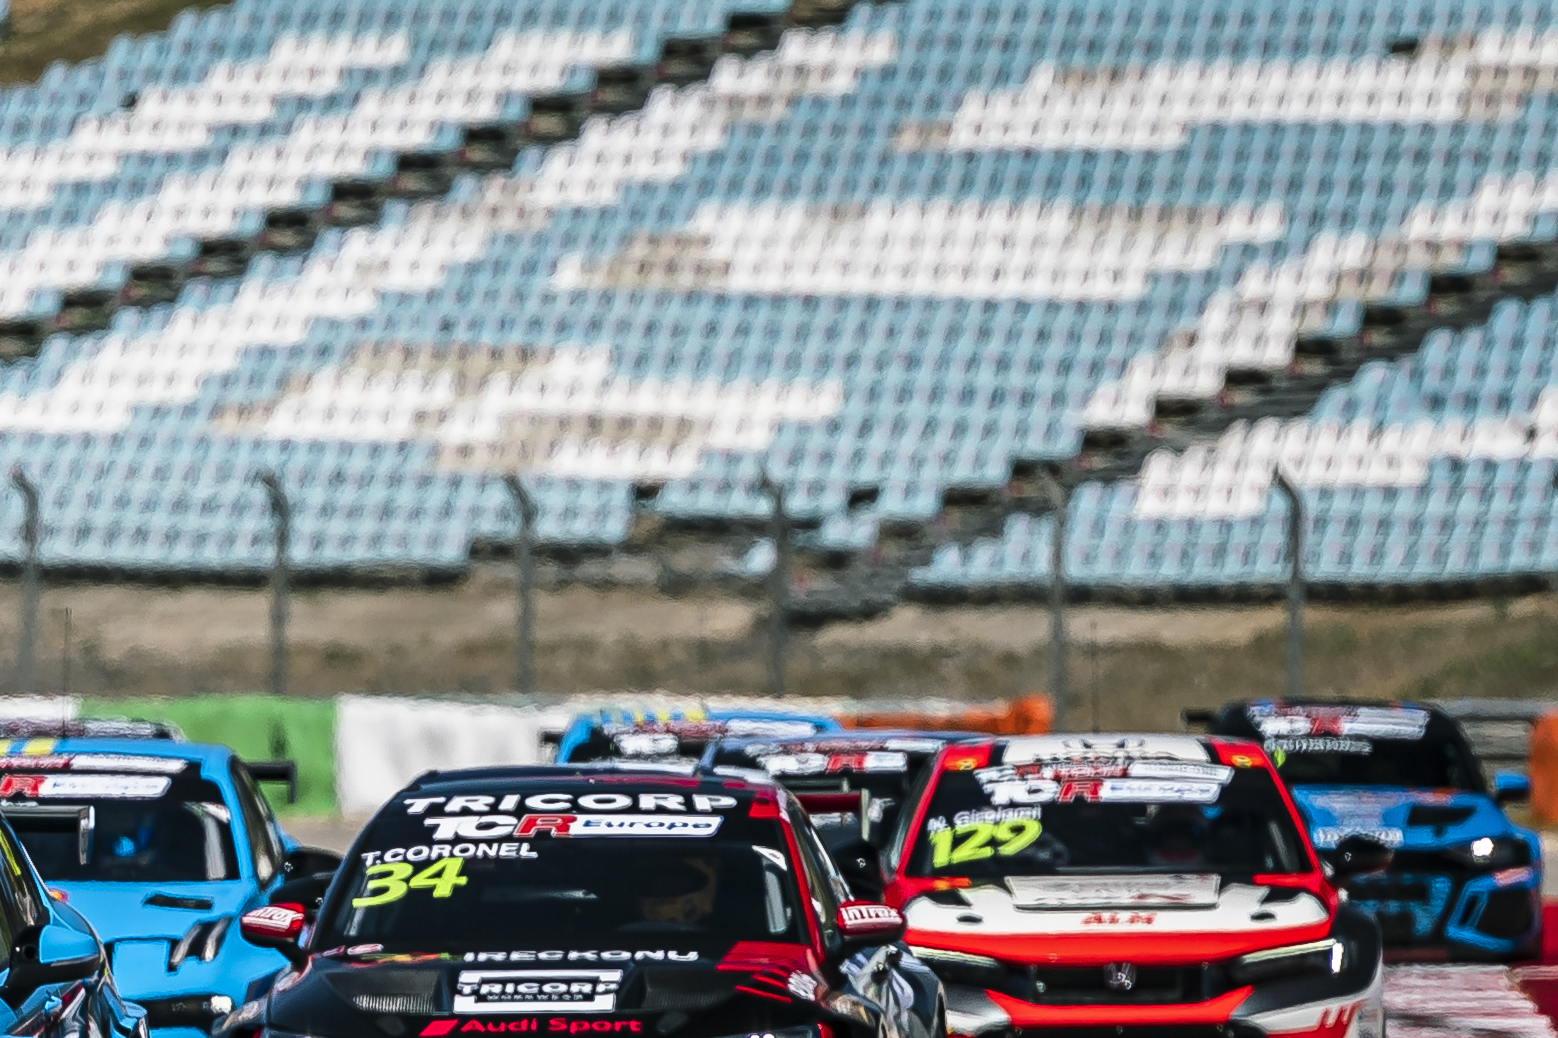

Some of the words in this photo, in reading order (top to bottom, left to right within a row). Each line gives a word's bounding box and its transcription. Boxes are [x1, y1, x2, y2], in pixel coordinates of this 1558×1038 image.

[403, 793, 737, 815] TRICORP
[424, 813, 576, 840] TCR
[581, 819, 714, 832] Europe
[360, 843, 538, 866] T.CORONEL
[929, 818, 1042, 869] 129
[352, 857, 469, 908] 34
[463, 950, 699, 962] IRECKONU
[460, 1017, 538, 1033] Audi
[548, 1017, 642, 1035] Sport
